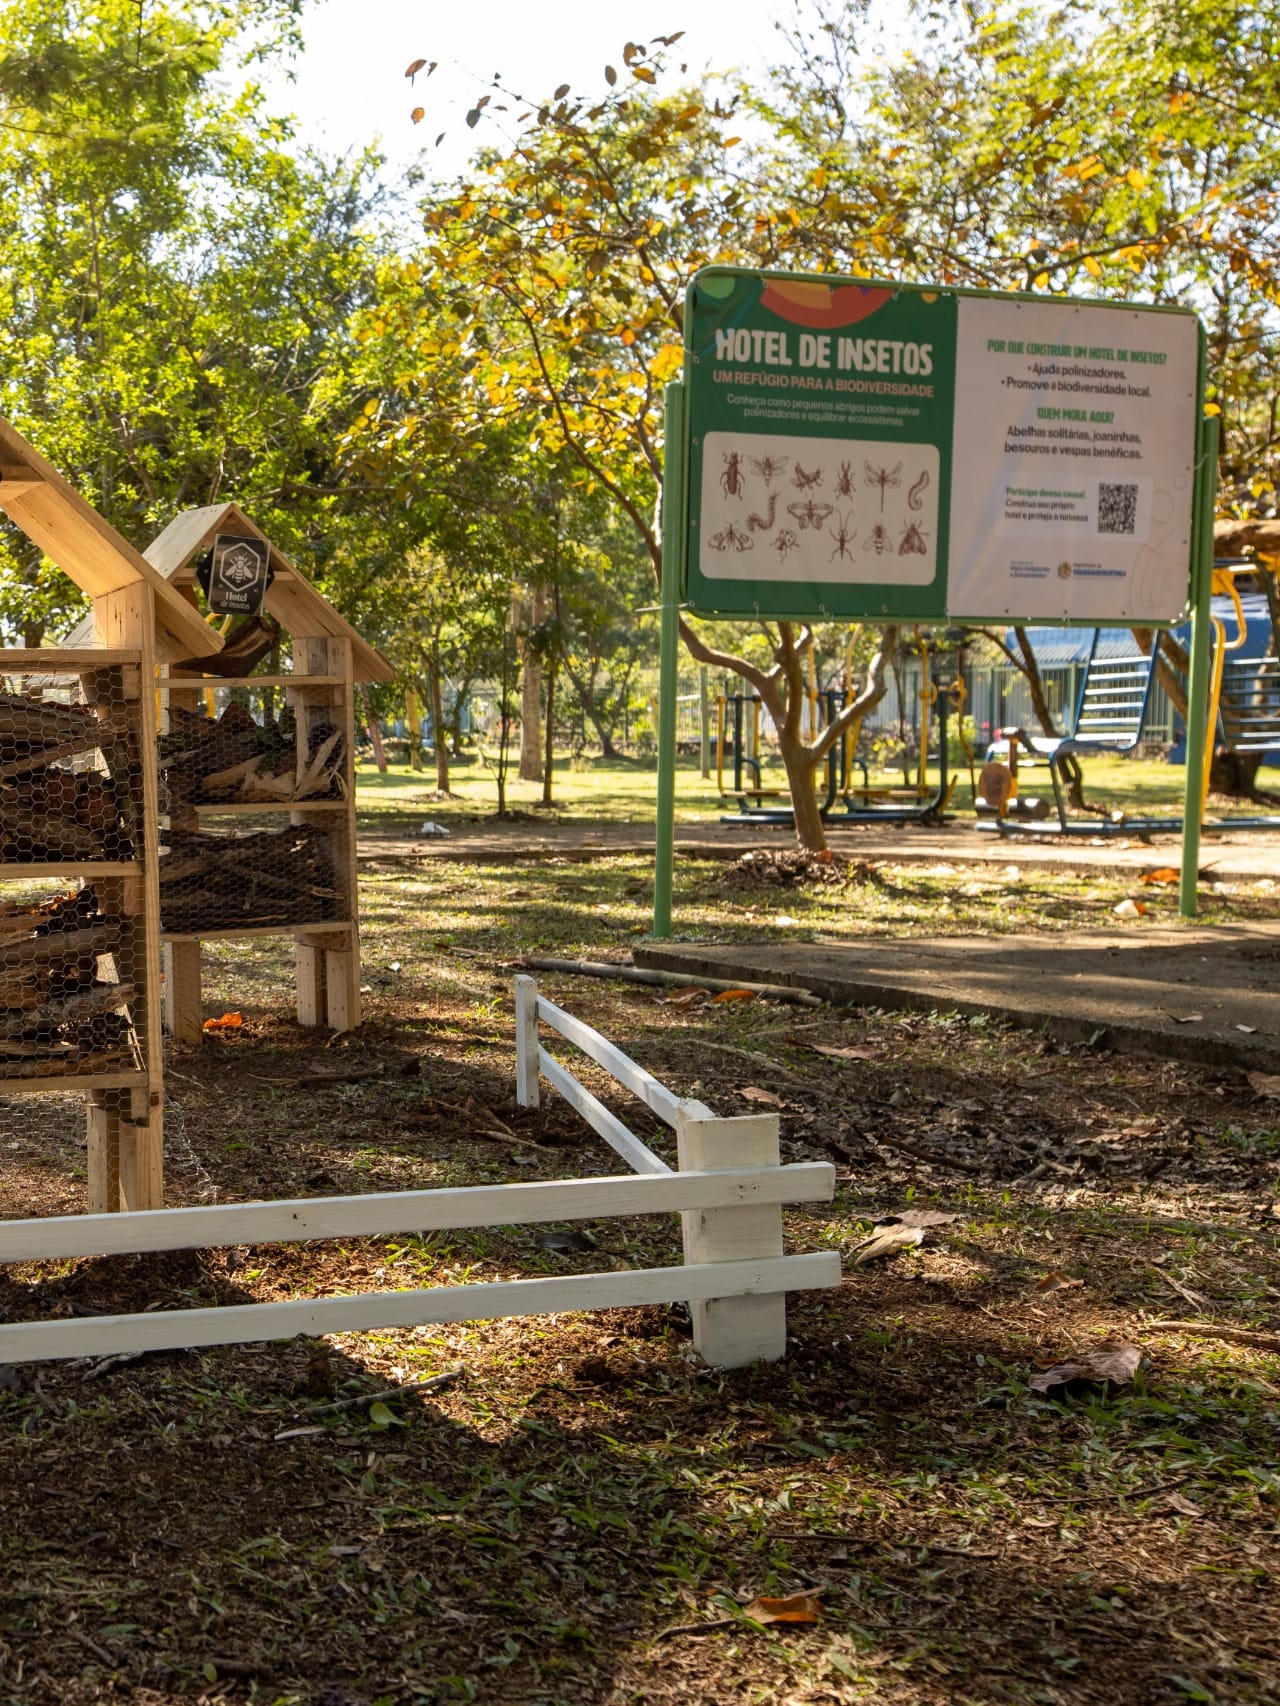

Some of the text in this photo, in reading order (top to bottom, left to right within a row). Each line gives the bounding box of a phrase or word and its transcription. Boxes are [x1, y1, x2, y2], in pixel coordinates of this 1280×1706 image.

[716, 328, 933, 376] HOTEL DE INSETOS
[988, 339, 1167, 365] POR QUE CONSTRUIR UM HOTEL DE INSETOS?
[1032, 363, 1127, 380] Ajuda polinizadores.
[712, 370, 934, 398] UM REFÚGIO PARA A BIODIVERSIDADE
[1006, 378, 1049, 391] Promove
[1057, 380, 1127, 396] biodiversidade
[1128, 386, 1152, 398] local.
[727, 394, 920, 416] Conheça como pequenos abrigos podem salvar
[744, 408, 904, 426] polinizadores e equilibrar ecossistemas
[1037, 407, 1114, 424] QUEM MORA AQUI?
[1008, 425, 1142, 444] Abelhas solitárias, joaninhas,
[1004, 442, 1143, 459] besouros e vespas benéficas.
[225, 592, 248, 602] Hotel
